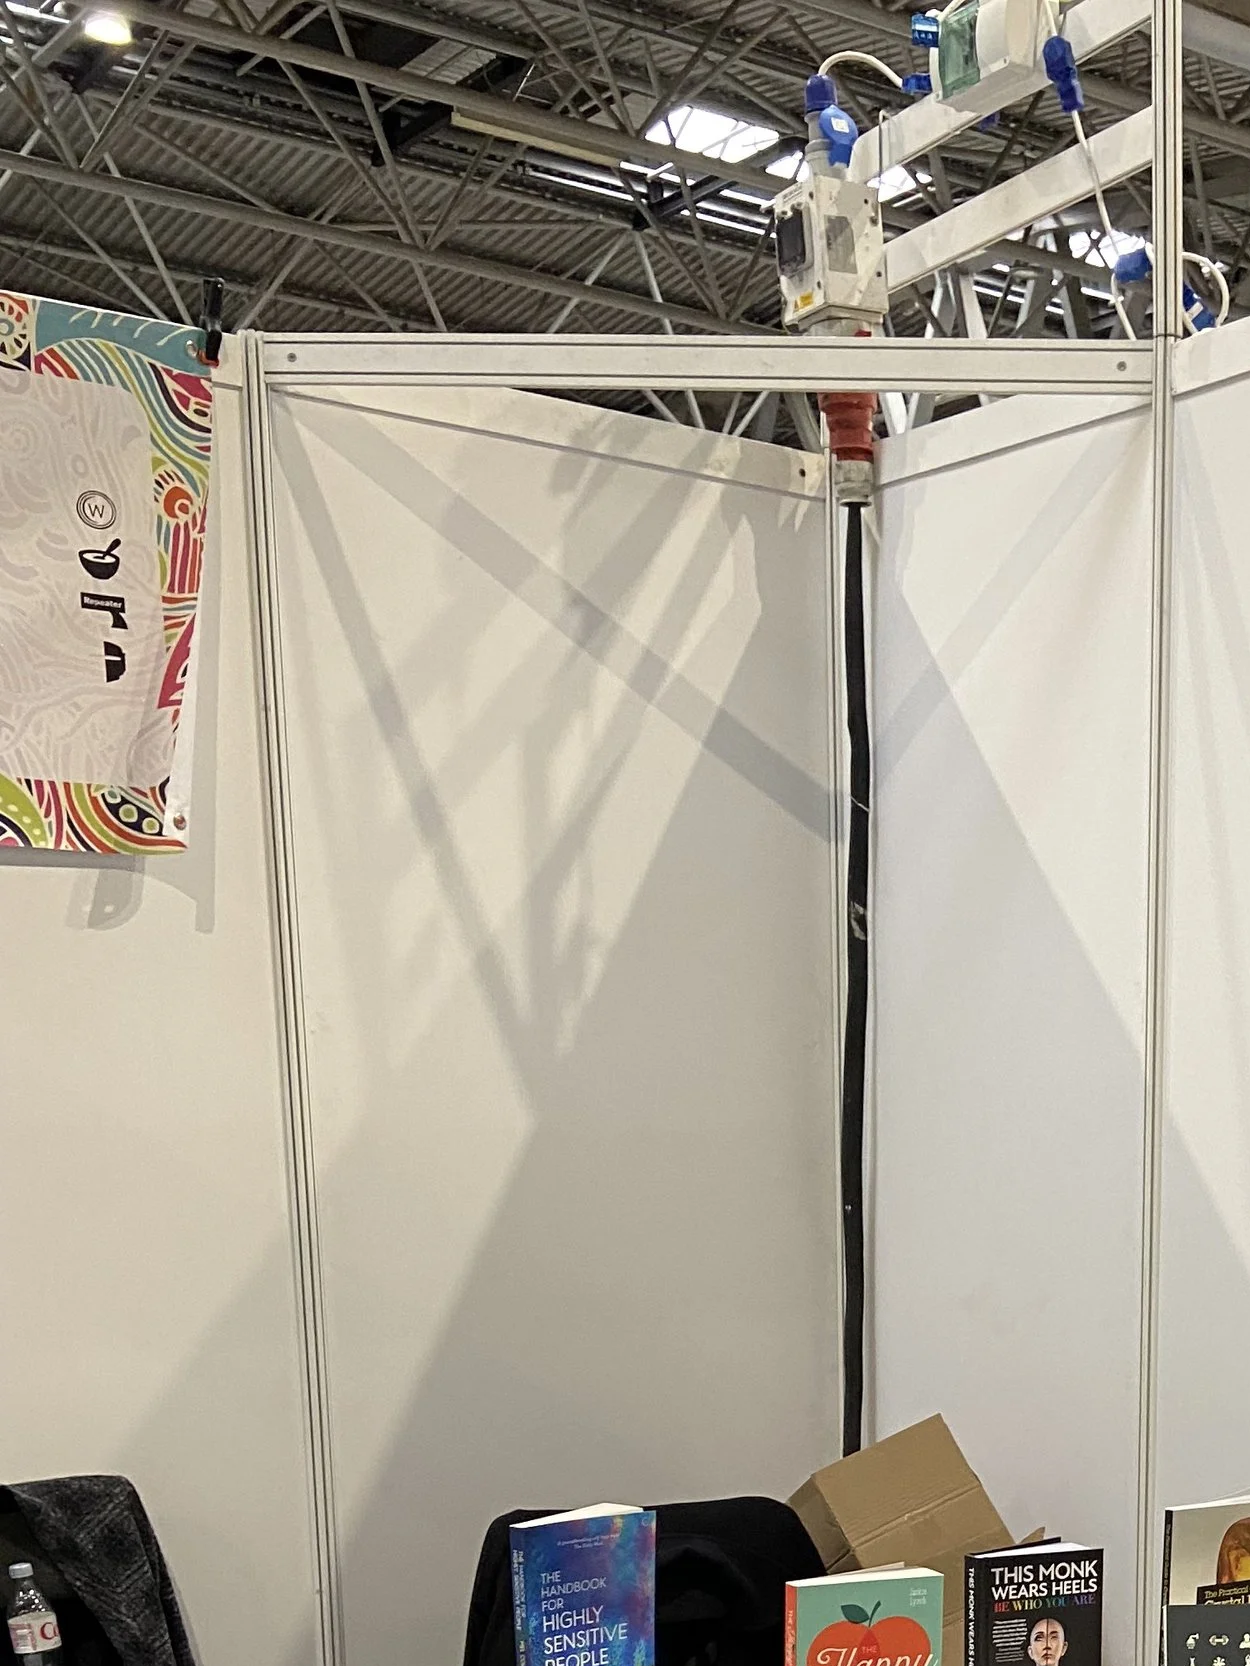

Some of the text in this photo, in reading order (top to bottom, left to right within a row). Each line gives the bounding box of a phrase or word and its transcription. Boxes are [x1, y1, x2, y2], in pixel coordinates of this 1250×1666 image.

[83, 596, 122, 609] Repeater
[541, 1571, 561, 1584] THE
[991, 1560, 1098, 1585] THIS MONK
[541, 1577, 607, 1599] HANDBOOK
[992, 1579, 1098, 1600] WEARS HEELS
[1219, 1585, 1249, 1597] Practical
[541, 1598, 564, 1612] FOR
[993, 1594, 1096, 1612] BE WHO YOU ARE
[543, 1605, 604, 1633] HIGHLY
[544, 1622, 628, 1655] SENSITIVE
